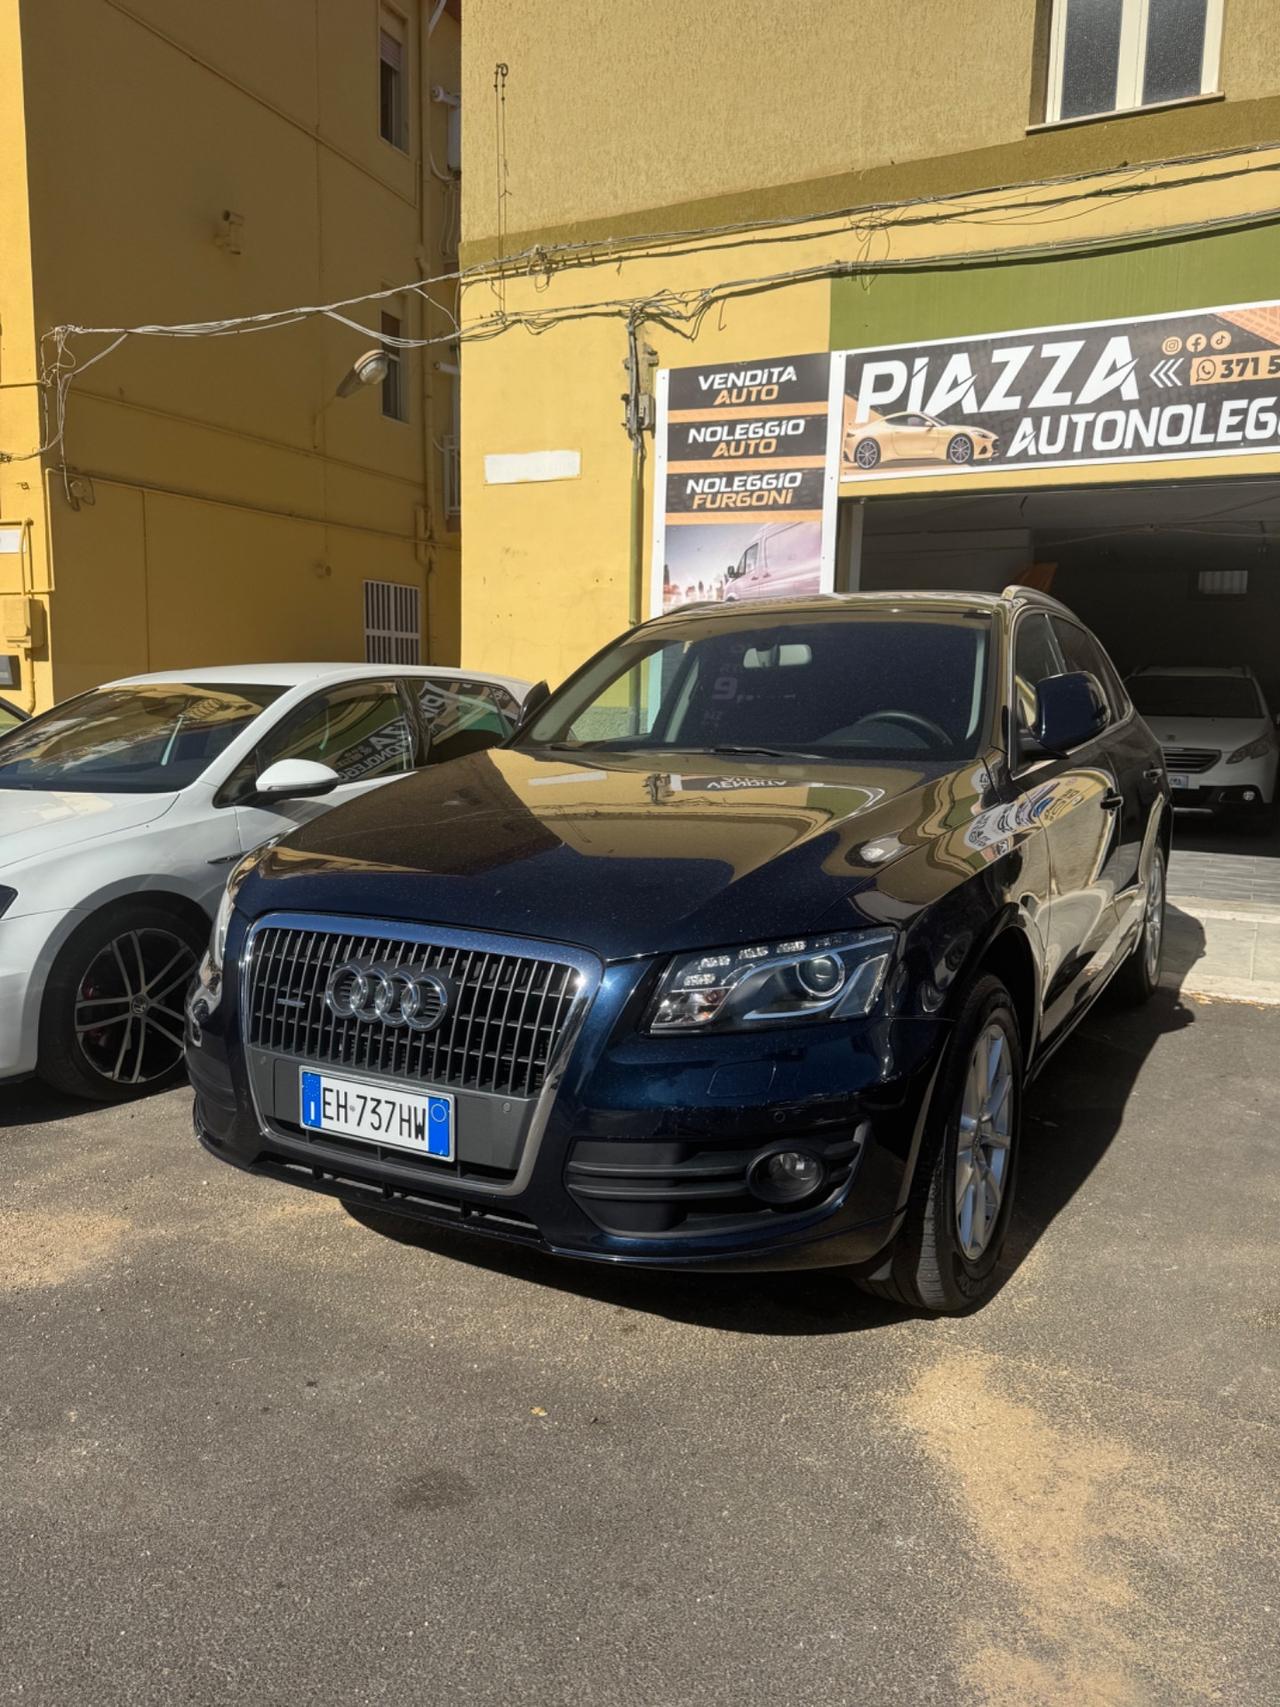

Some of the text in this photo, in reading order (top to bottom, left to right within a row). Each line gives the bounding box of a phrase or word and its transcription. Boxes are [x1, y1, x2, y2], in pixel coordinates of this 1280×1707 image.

[698, 365, 798, 391] VENDITA
[855, 335, 1140, 423] PIAZZA
[1219, 357, 1260, 379] 371
[713, 384, 779, 406] AUTO
[688, 419, 806, 444] NOLEGGIO
[1006, 396, 1280, 458] AUTONOLEG
[712, 438, 778, 458] AUTO
[686, 471, 803, 495] NOLEGGIO
[692, 489, 794, 510] FURGONI
